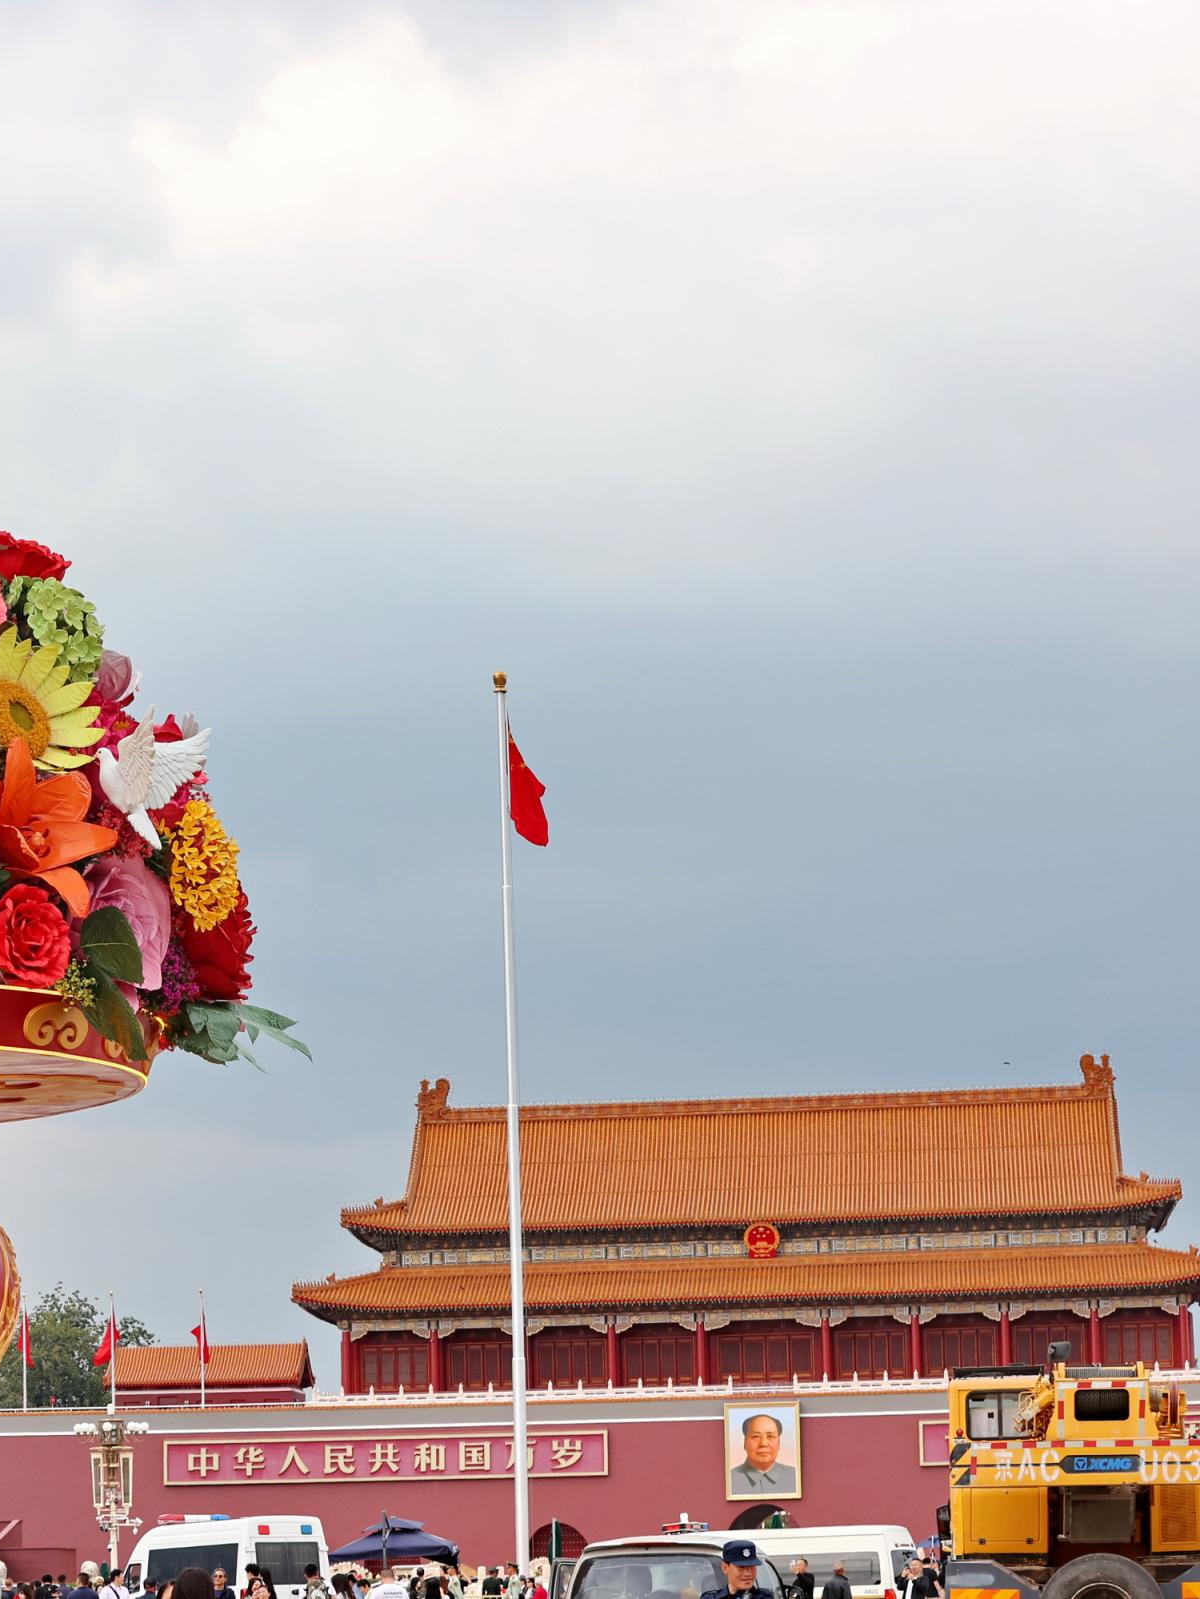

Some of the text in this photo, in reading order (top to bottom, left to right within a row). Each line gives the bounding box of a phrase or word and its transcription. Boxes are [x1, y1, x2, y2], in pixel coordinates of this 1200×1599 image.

[187, 1439, 583, 1477] 中华人民共和国万岁
[1088, 1457, 1132, 1471] XCMG
